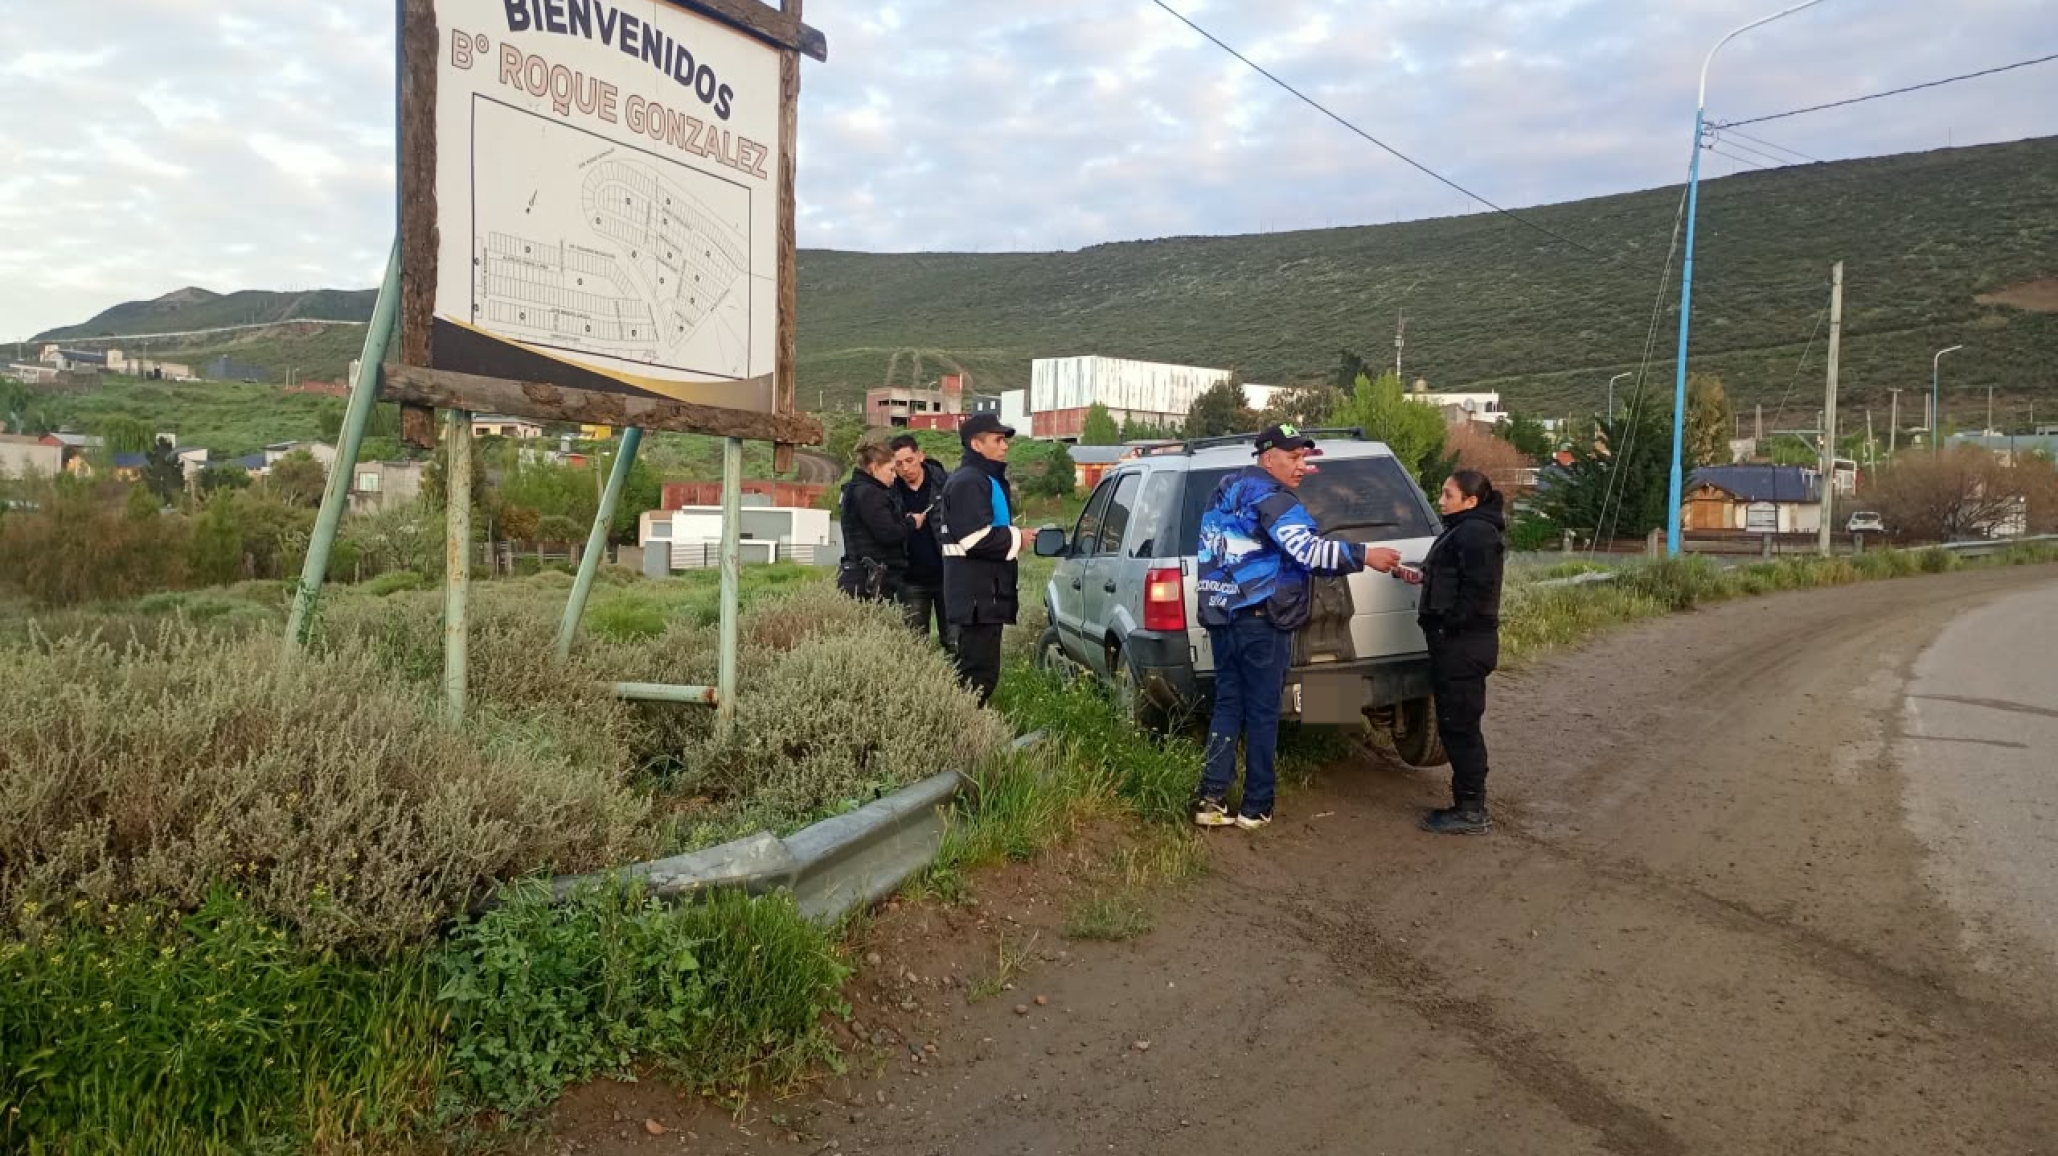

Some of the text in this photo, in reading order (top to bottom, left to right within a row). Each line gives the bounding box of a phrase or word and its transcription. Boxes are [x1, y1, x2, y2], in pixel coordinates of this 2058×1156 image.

[499, 41, 618, 124] ROQUE
[625, 94, 768, 180] GONZALEZ
[504, 0, 734, 121] BIENVENIDOS
